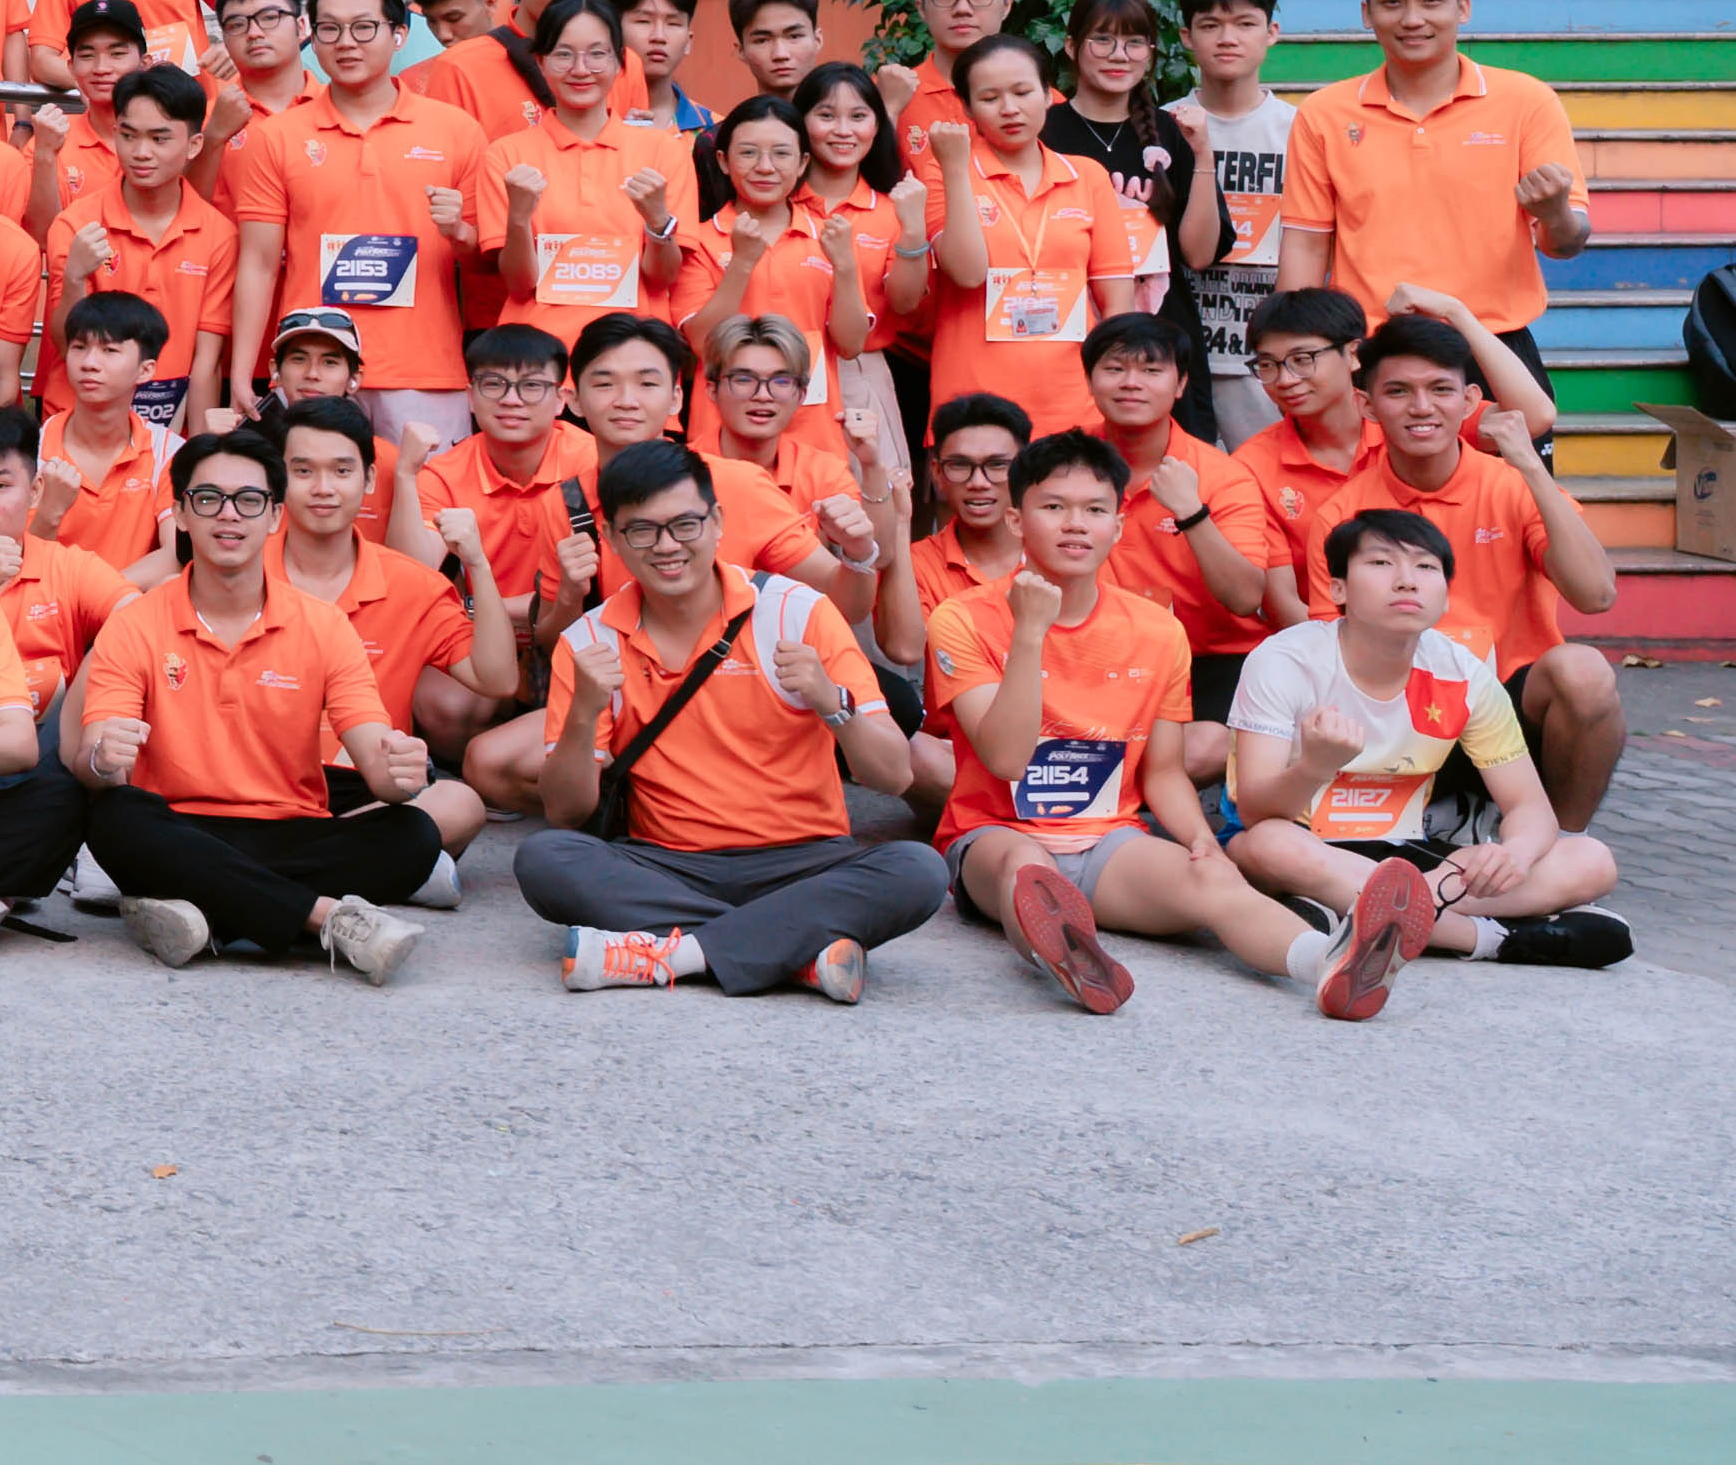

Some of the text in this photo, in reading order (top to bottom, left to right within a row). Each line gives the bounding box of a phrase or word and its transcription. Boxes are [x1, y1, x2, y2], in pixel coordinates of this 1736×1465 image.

[336, 259, 388, 278] 21153
[554, 263, 622, 281] 21089
[1027, 766, 1090, 785] 21154
[1331, 789, 1392, 808] 21127
